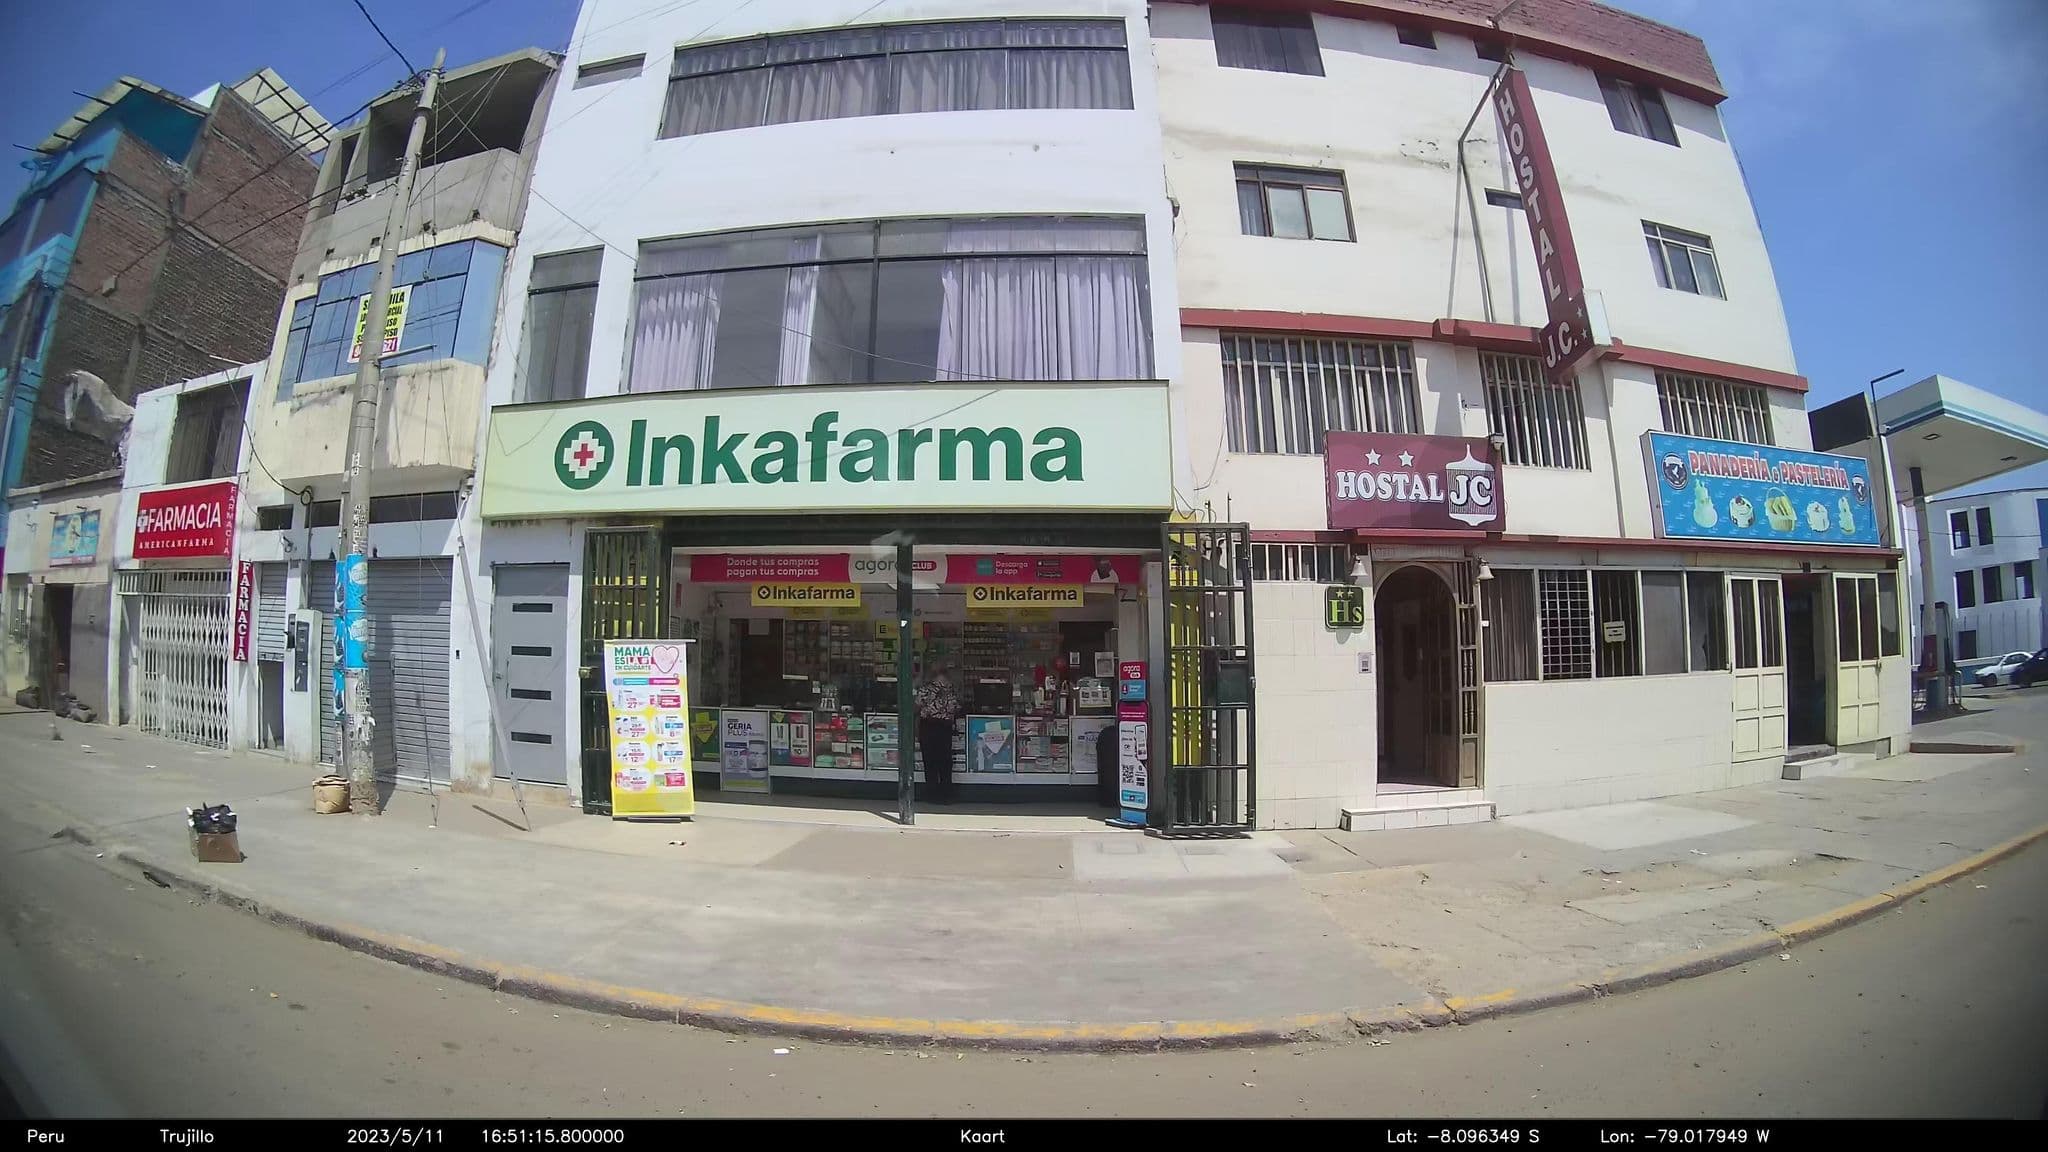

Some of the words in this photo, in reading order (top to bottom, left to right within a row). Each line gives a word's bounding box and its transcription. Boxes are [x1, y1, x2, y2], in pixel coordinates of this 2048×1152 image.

[1500, 88, 1562, 302] HOSTAL
[1546, 321, 1579, 368] J.C.
[627, 411, 1083, 486] Inkafarma
[1688, 450, 1772, 482] PANADERÍA
[1779, 461, 1850, 490] PASTELERÍA
[1336, 470, 1444, 502] HOSTAL
[1449, 474, 1492, 507] JC
[147, 502, 221, 533] FARMACIA
[223, 486, 237, 554] FARMACIA
[726, 567, 758, 577] pagan
[760, 567, 775, 576] tus
[777, 568, 820, 577] compras
[761, 558, 775, 566] tus
[777, 559, 820, 568] compras
[855, 560, 897, 574] agor
[995, 560, 1028, 569] Descarga
[773, 585, 855, 600] Inkafarma
[990, 586, 1077, 601] Inkafarma
[235, 562, 251, 660] FARMACIA
[1329, 599, 1363, 623] Hs
